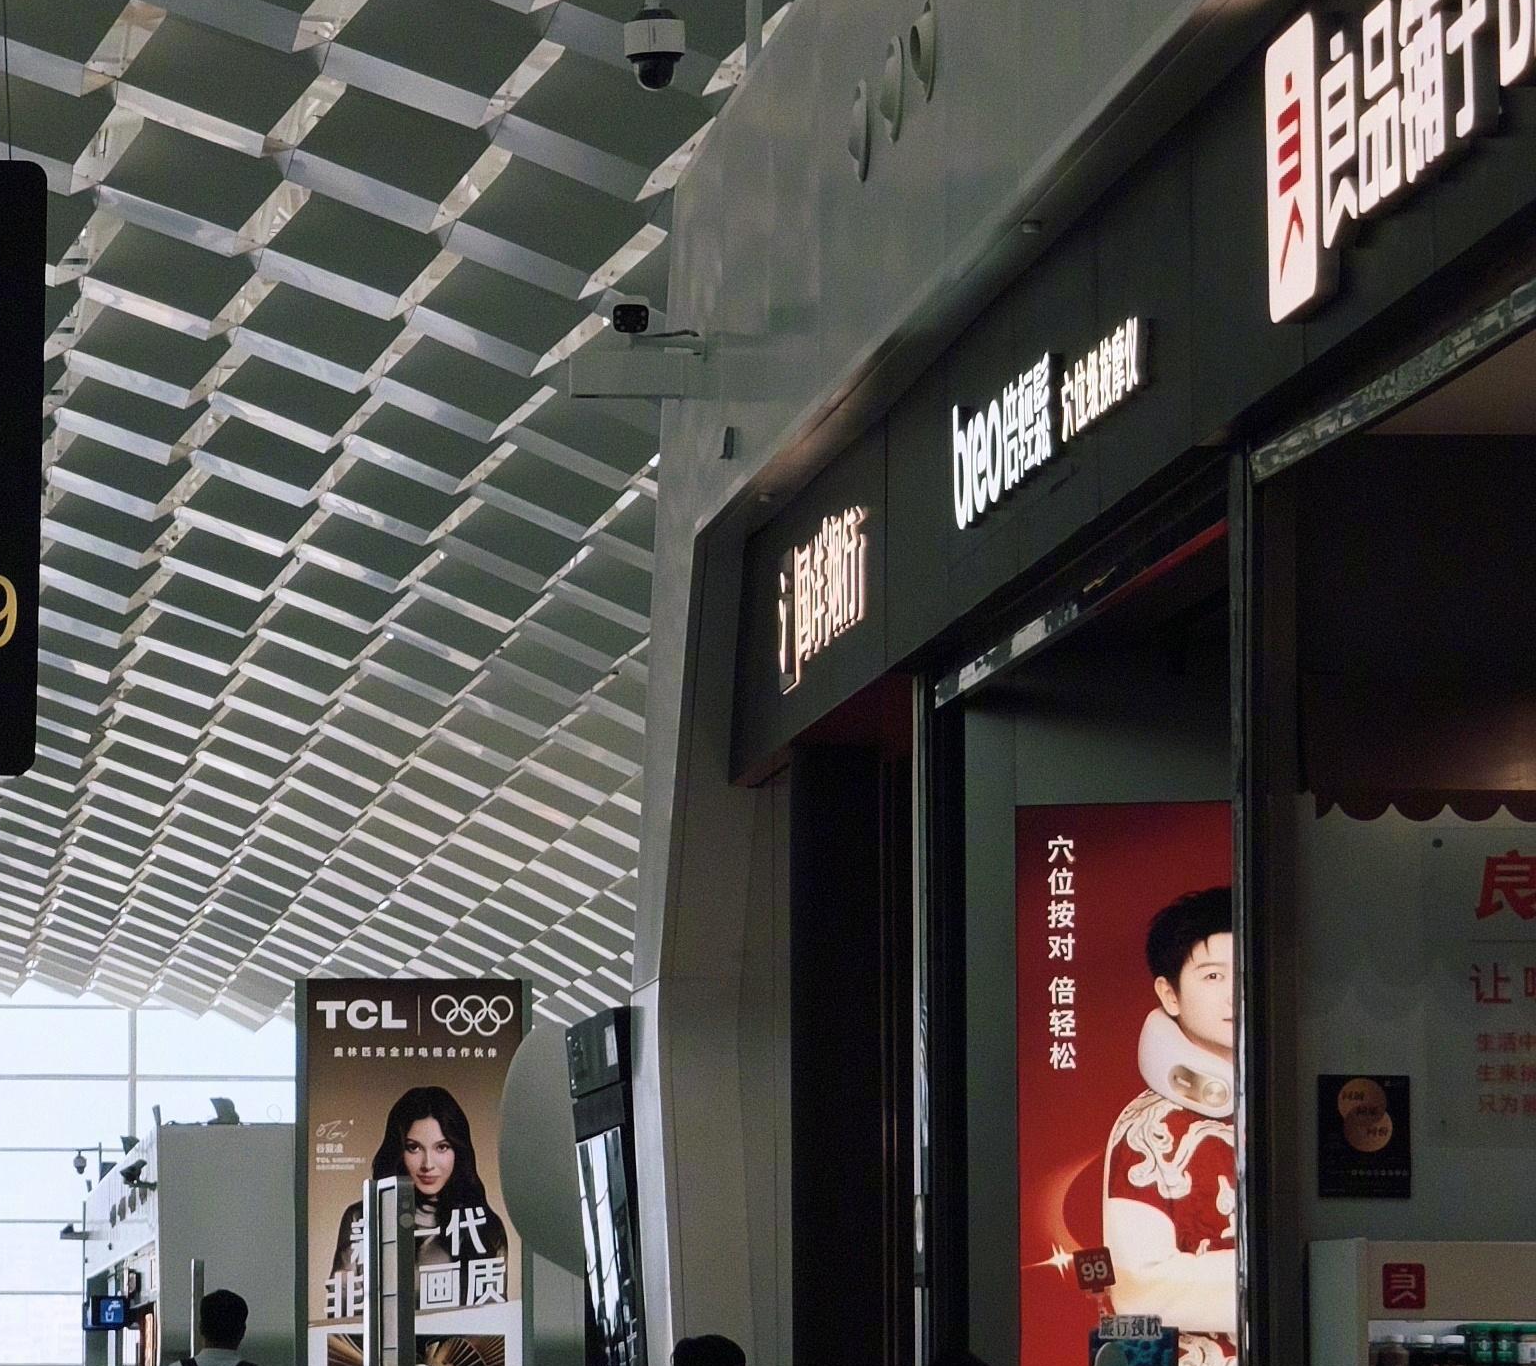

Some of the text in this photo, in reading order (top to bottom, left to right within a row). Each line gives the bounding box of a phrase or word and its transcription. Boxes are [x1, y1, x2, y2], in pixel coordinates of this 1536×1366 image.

[953, 399, 1002, 530] breo
[1047, 835, 1077, 1070] 穴位按对 倍轻松
[316, 999, 407, 1029] TCL
[333, 1046, 498, 1059] 奥林匹克全球电视合作伙伴
[1081, 1261, 1108, 1282] 99
[324, 1257, 507, 1319] 非画质
[1100, 1316, 1162, 1337] 旅行颈枕
